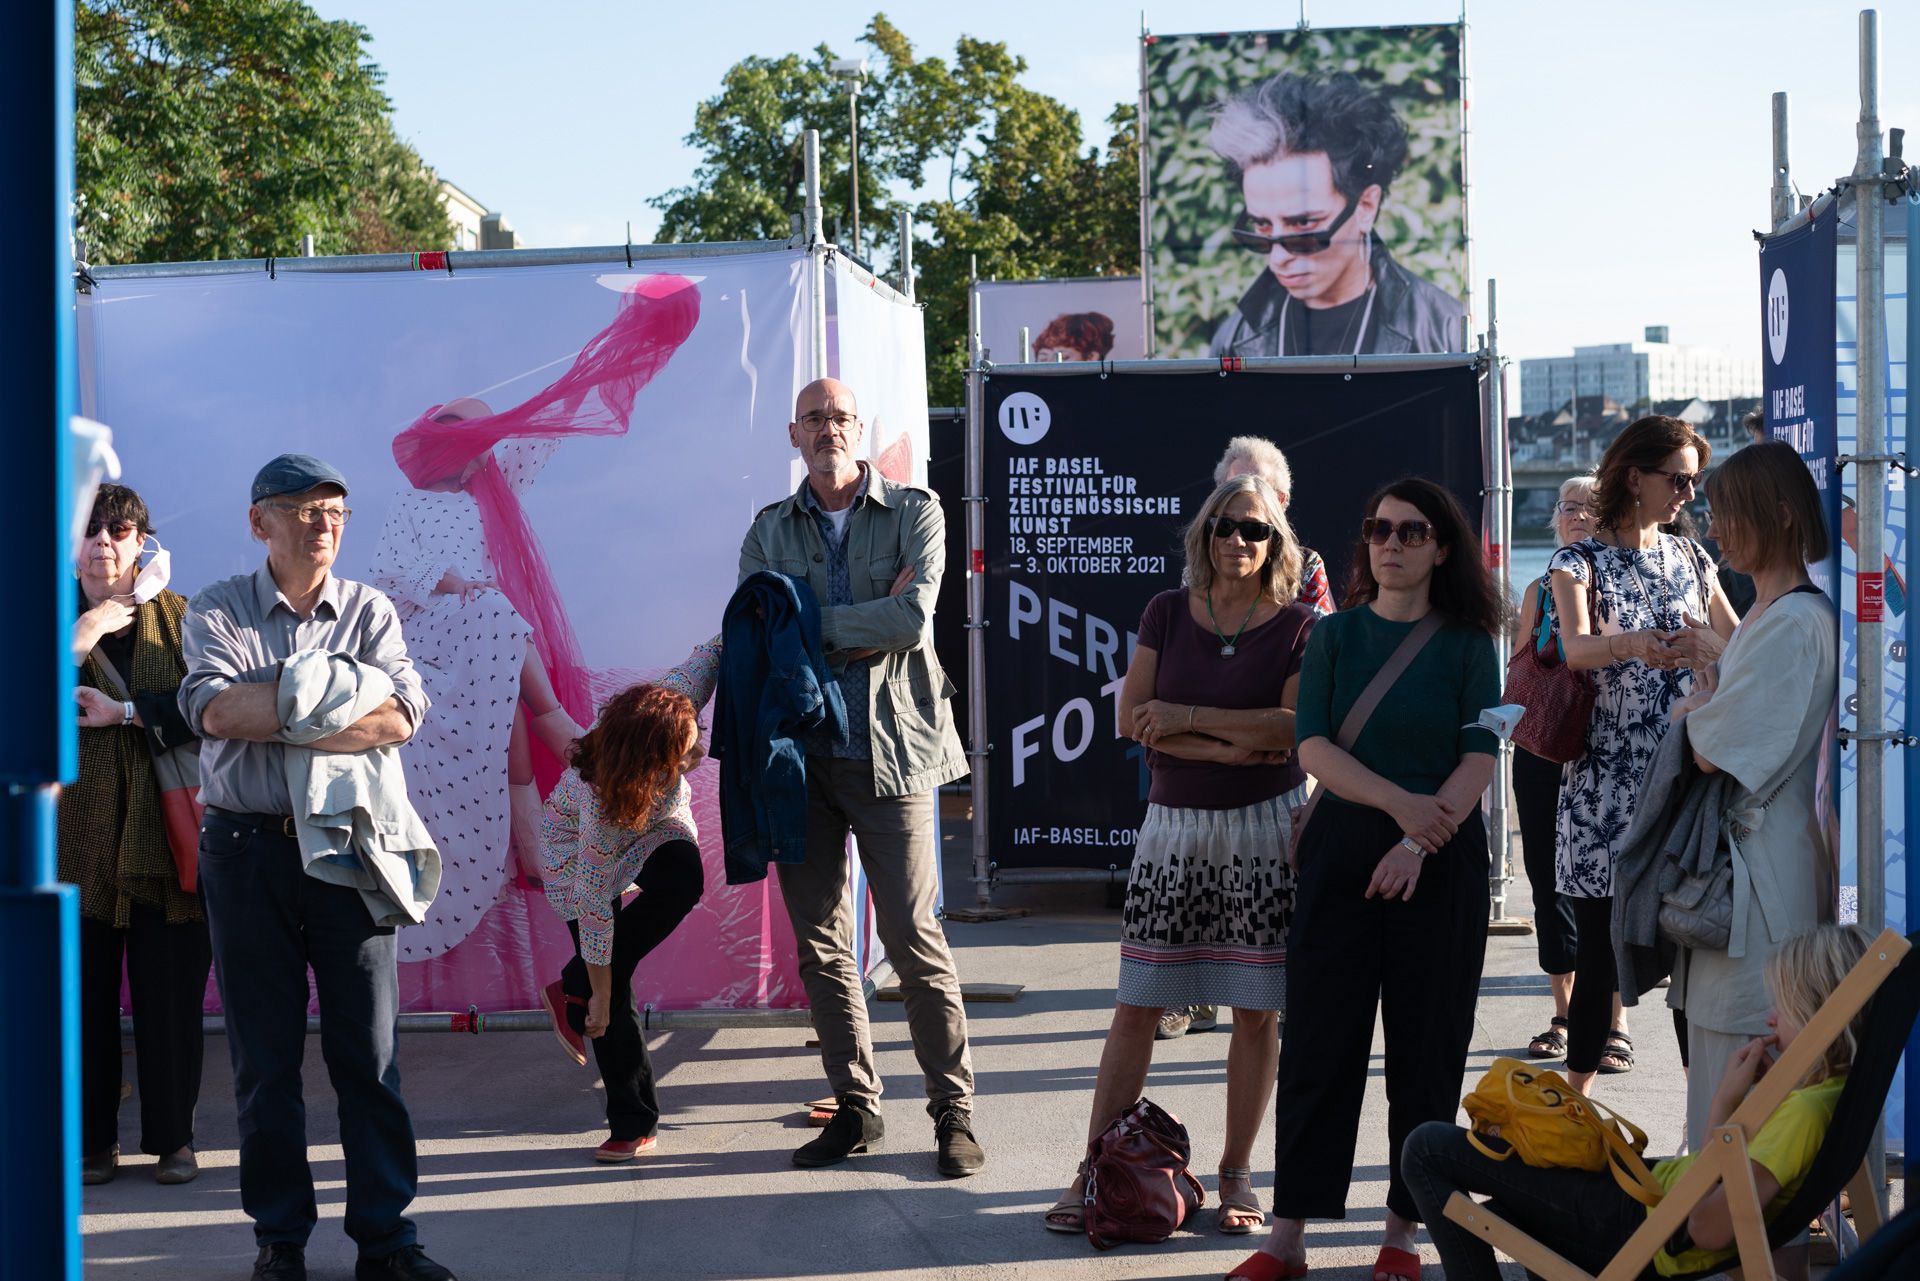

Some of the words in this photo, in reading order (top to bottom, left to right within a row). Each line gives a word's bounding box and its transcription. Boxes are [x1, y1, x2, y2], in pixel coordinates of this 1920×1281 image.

[1772, 389, 1784, 420] IAF
[1785, 385, 1805, 419] BASEL
[1802, 418, 1815, 454] FÜR
[1009, 457, 1039, 475] IAF
[1046, 457, 1104, 475] BASEL
[1009, 477, 1098, 495] FESTIVAL
[1102, 475, 1137, 495] FÜR
[1009, 496, 1181, 515] ZEITGENÖSSISCHE
[1009, 517, 1071, 535] KUNST
[1010, 537, 1031, 554] 18.
[1036, 537, 1133, 554] SEPTEMBER
[1026, 557, 1041, 574] 3.
[1047, 557, 1121, 574] OKTOBER
[1127, 557, 1165, 574] 2021
